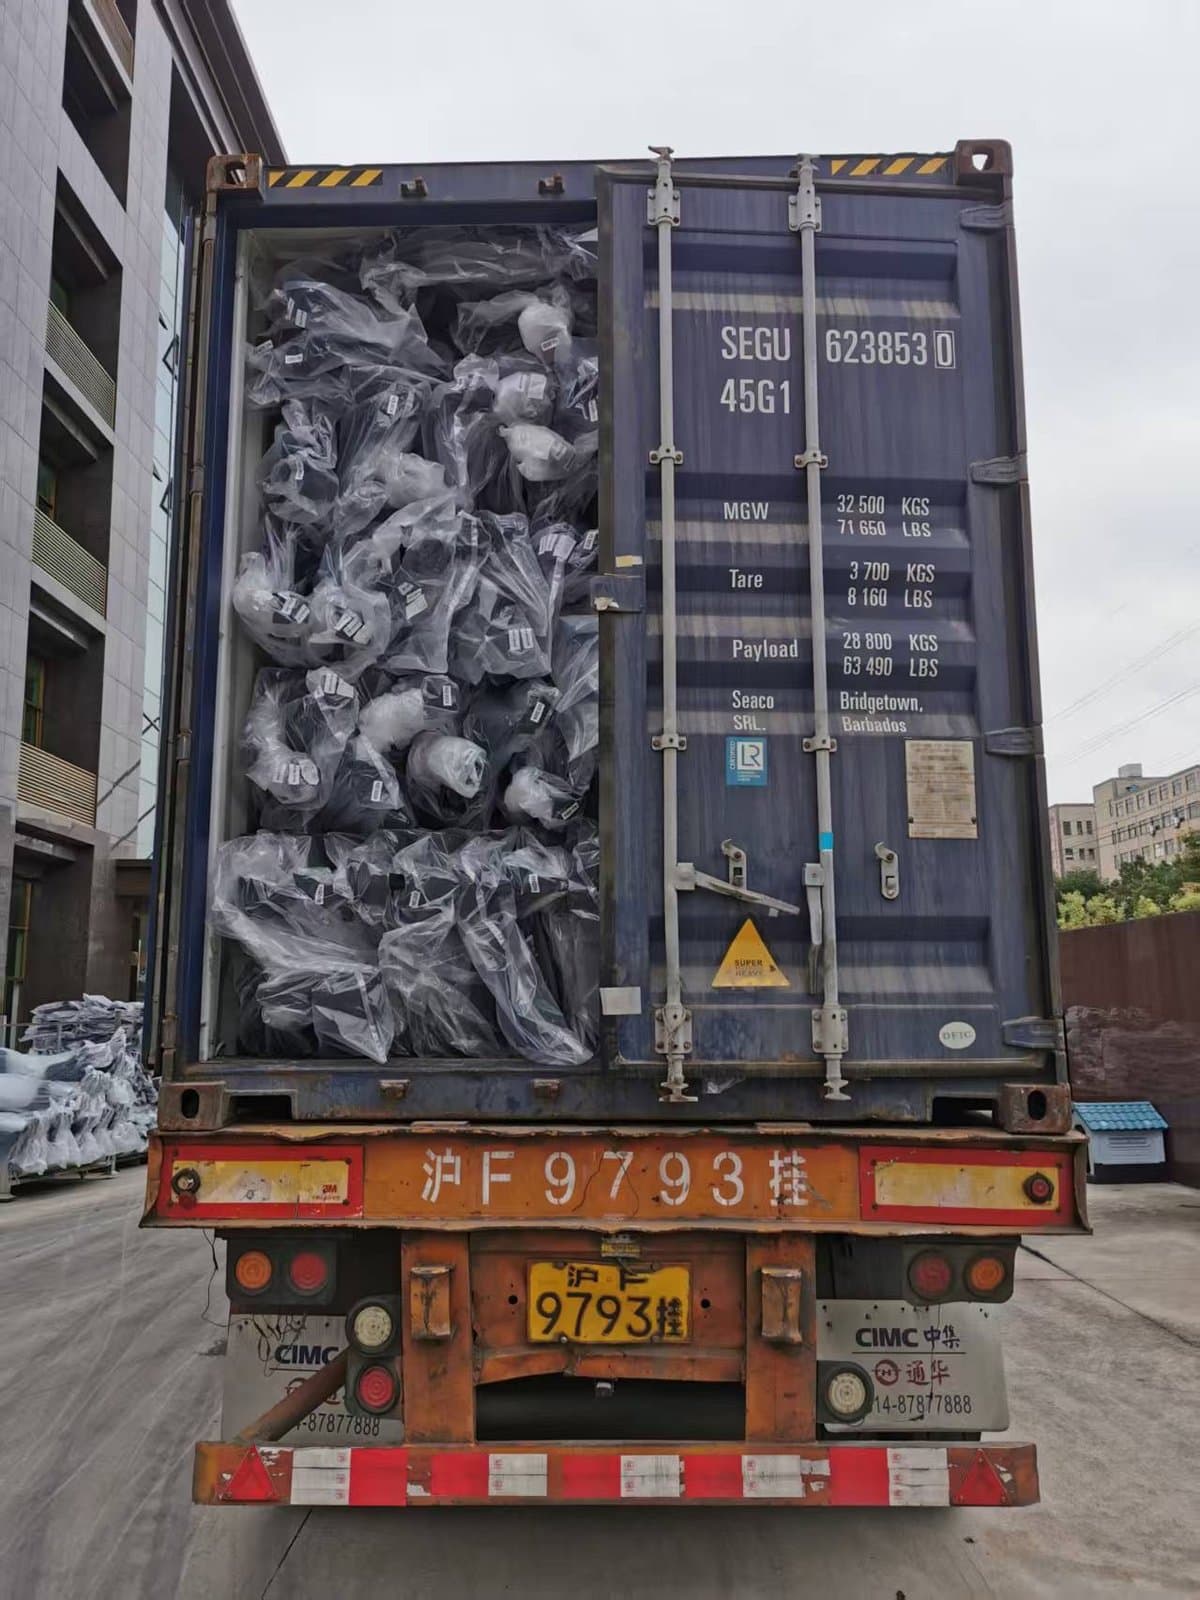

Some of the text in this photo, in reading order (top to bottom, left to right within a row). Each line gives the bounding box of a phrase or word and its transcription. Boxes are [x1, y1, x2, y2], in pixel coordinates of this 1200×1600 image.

[721, 326, 952, 366] SEGU 623853 0
[720, 379, 790, 414] 45G1
[723, 495, 930, 520] MGW 32 500 KGS
[838, 519, 932, 537] 71 650 LBS
[730, 561, 936, 588] Tare 3 700 KGS
[848, 588, 932, 608] 8 160 LBS
[732, 632, 938, 662] Payload 28 800 KGS
[843, 656, 938, 677] 63 490 LBS
[732, 690, 923, 714] Seaco Bridgetown,
[734, 714, 907, 733] SRL. Barbados
[856, 1325, 960, 1350] CIMC 中集
[906, 1360, 950, 1386] 通华
